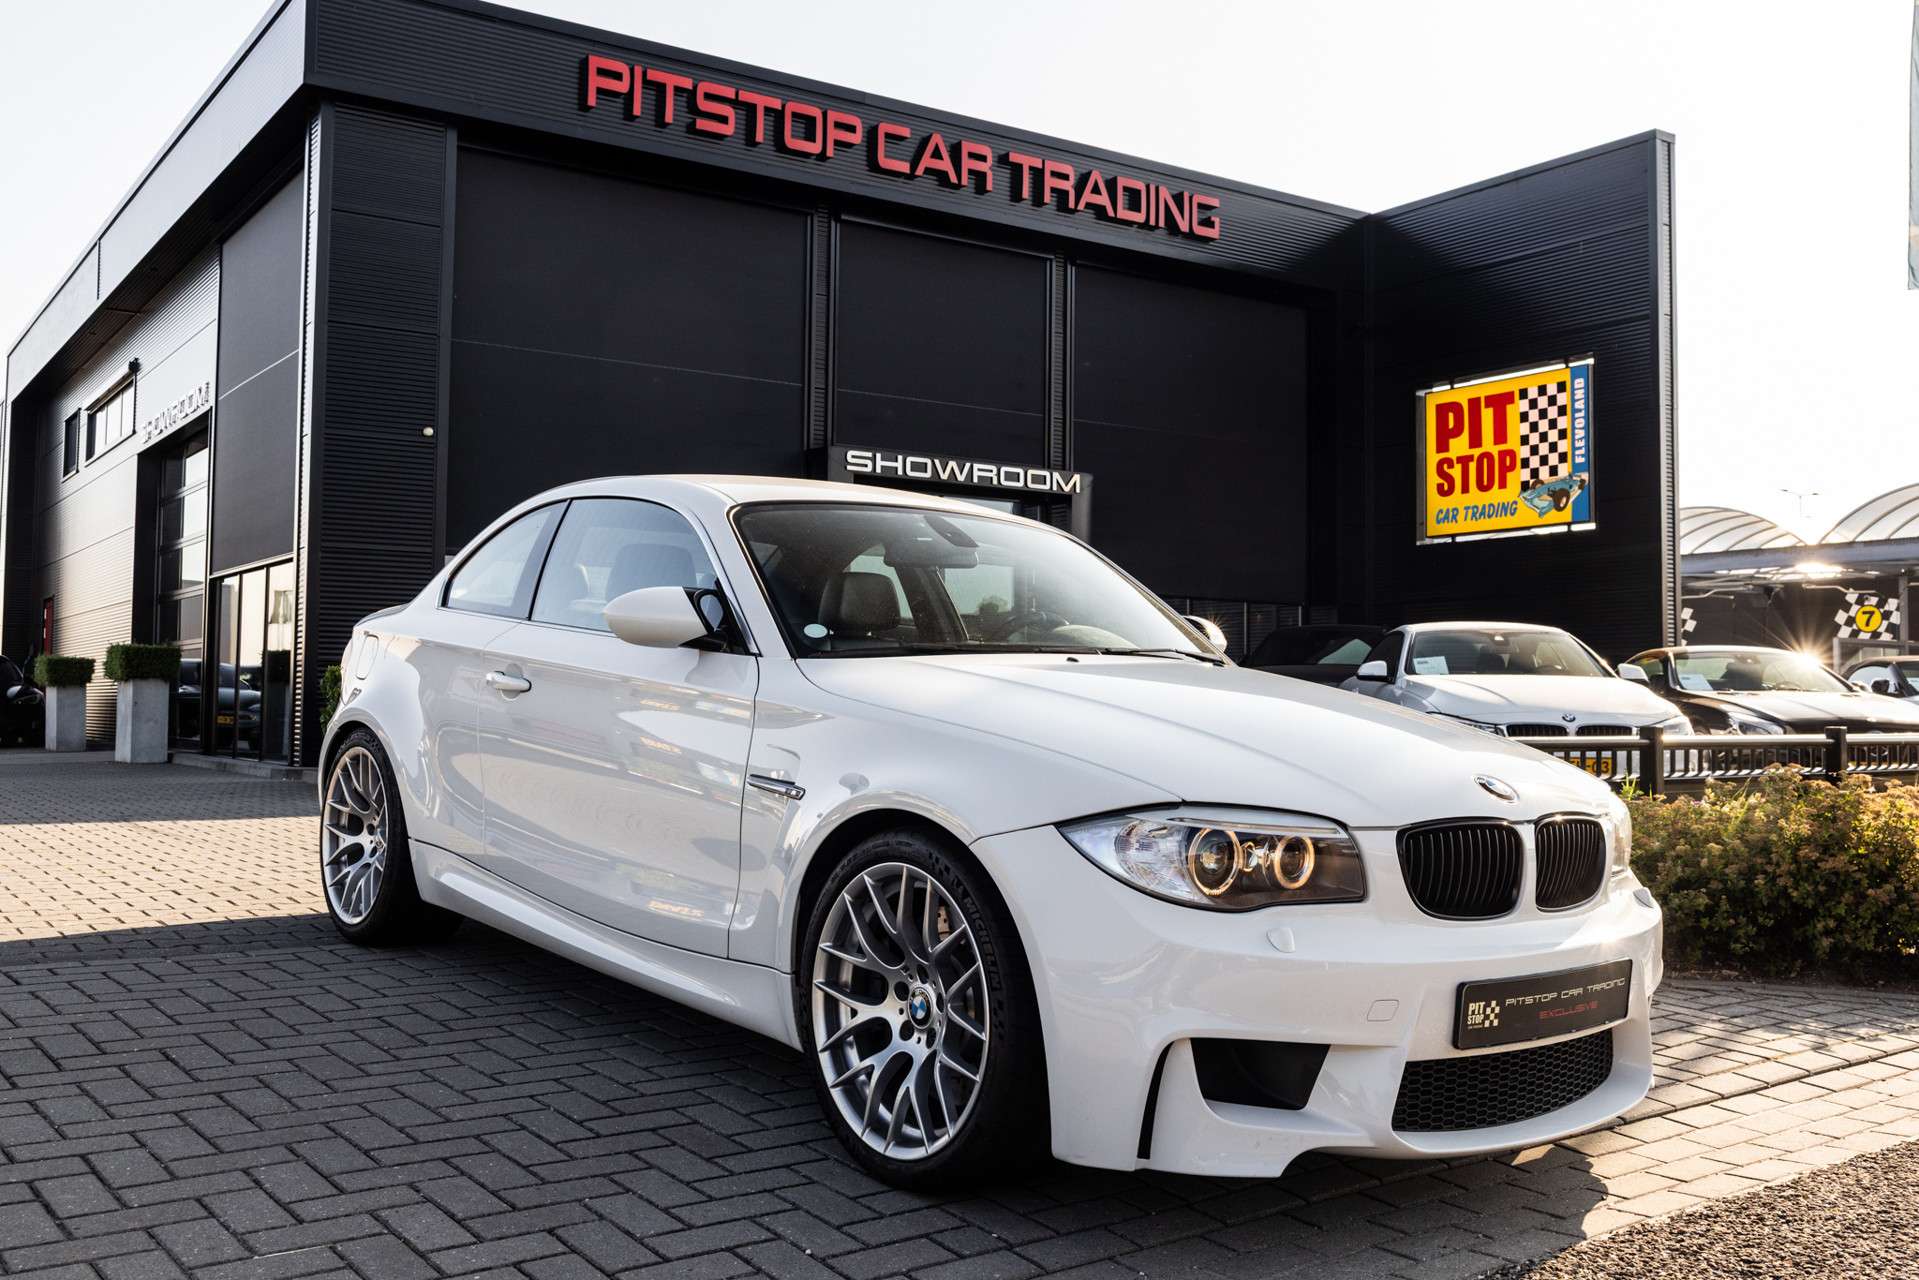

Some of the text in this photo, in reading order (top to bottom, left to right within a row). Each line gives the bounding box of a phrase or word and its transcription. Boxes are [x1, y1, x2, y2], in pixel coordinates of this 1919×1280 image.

[587, 54, 1220, 240] PITSTOP CAR TRADING
[1435, 390, 1515, 454] PIT
[1574, 377, 1586, 464] FLEVOLAND
[846, 450, 1081, 494] SHOWROOM
[1435, 448, 1517, 498] STOP
[1435, 500, 1519, 525] CAR TRADING
[1862, 610, 1875, 627] 7
[1505, 977, 1626, 1007] PITSTOP CAR TRADING
[1467, 1014, 1485, 1025] STOP
[1468, 1001, 1486, 1015] PIT
[1538, 1001, 1598, 1019] EXCLUSIVE
